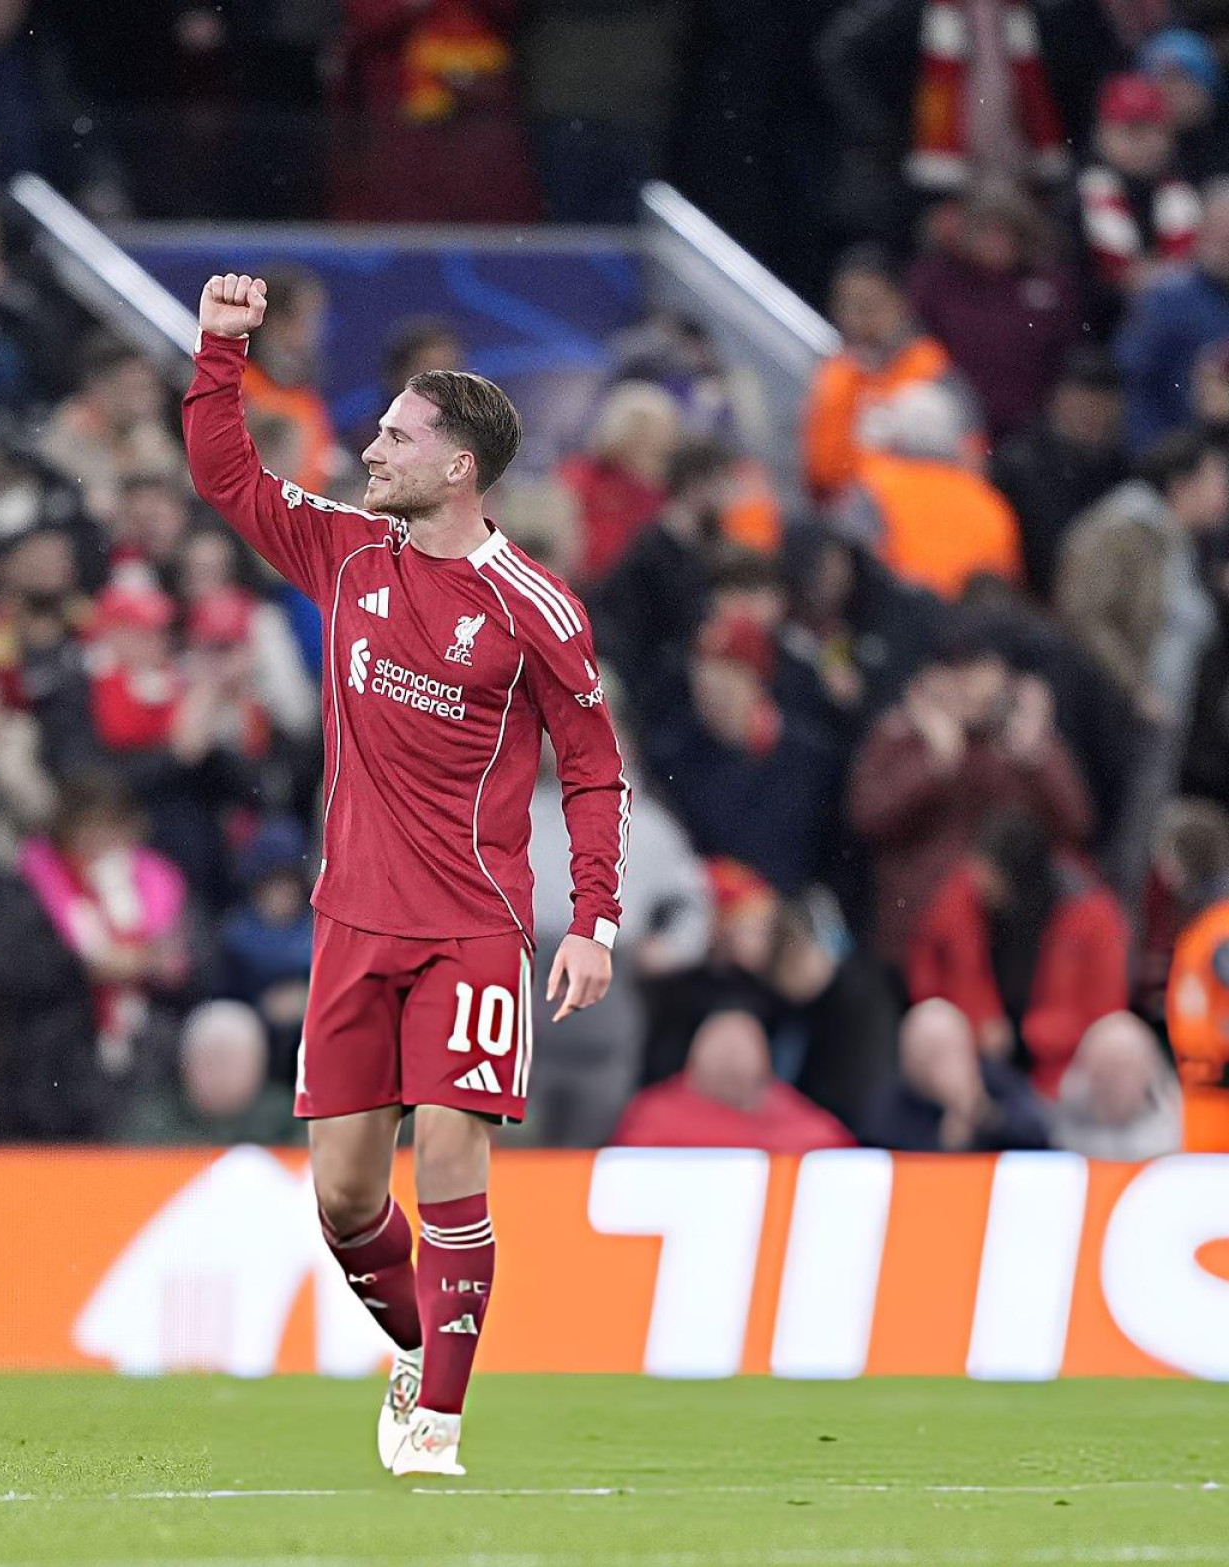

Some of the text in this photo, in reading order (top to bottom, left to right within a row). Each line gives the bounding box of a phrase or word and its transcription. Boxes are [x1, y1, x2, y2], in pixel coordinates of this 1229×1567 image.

[371, 677, 465, 721] chartered
[374, 658, 463, 703] standard
[447, 981, 514, 1057] 10
